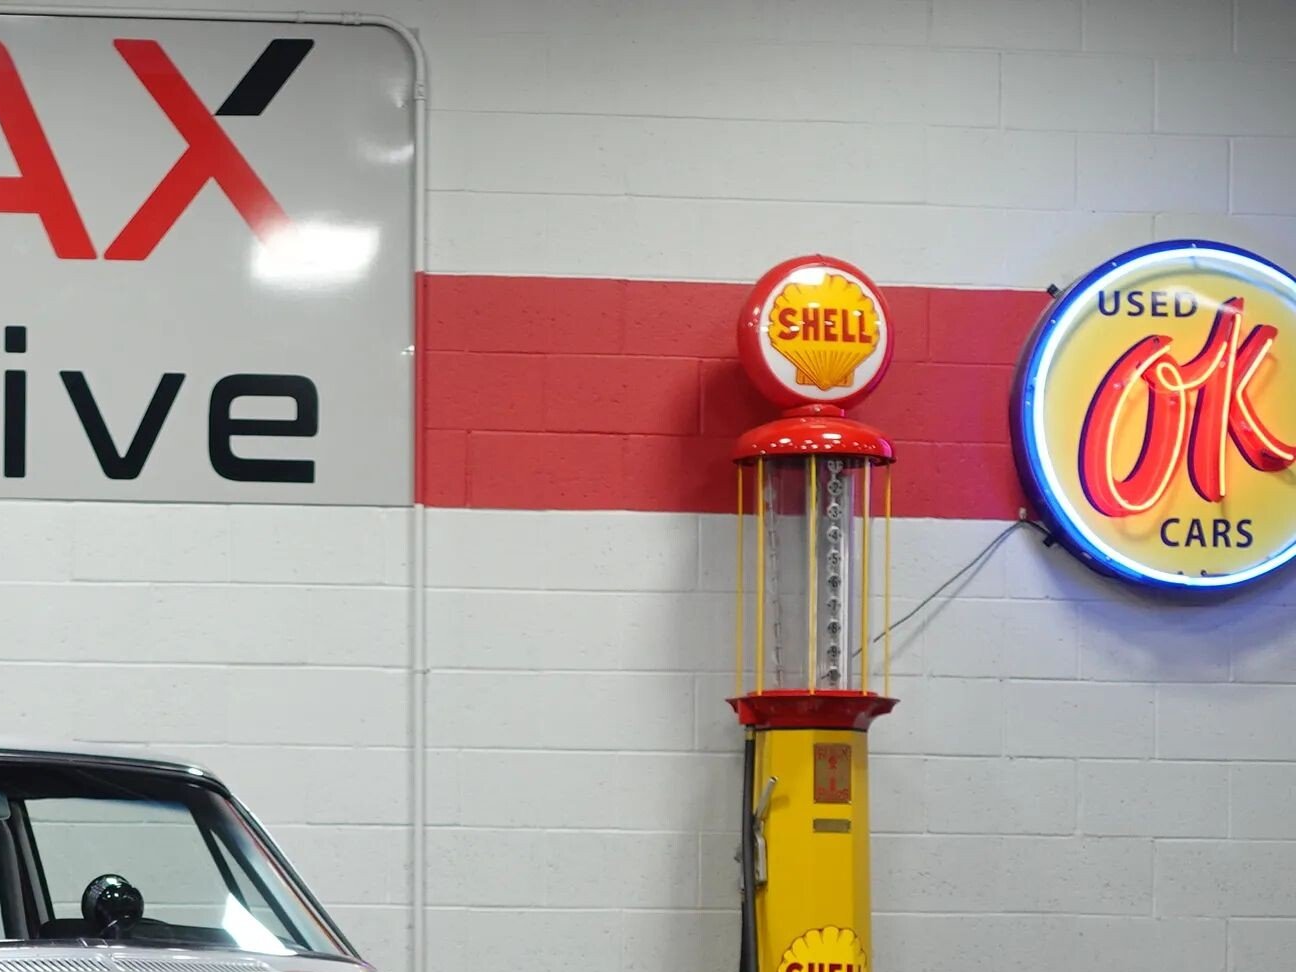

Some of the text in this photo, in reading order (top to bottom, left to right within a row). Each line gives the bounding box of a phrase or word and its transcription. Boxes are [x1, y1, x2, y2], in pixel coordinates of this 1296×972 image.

[1097, 290, 1198, 318] USED
[777, 307, 873, 344] SHELL
[1078, 297, 1296, 517] OK
[1160, 518, 1253, 548] CARS
